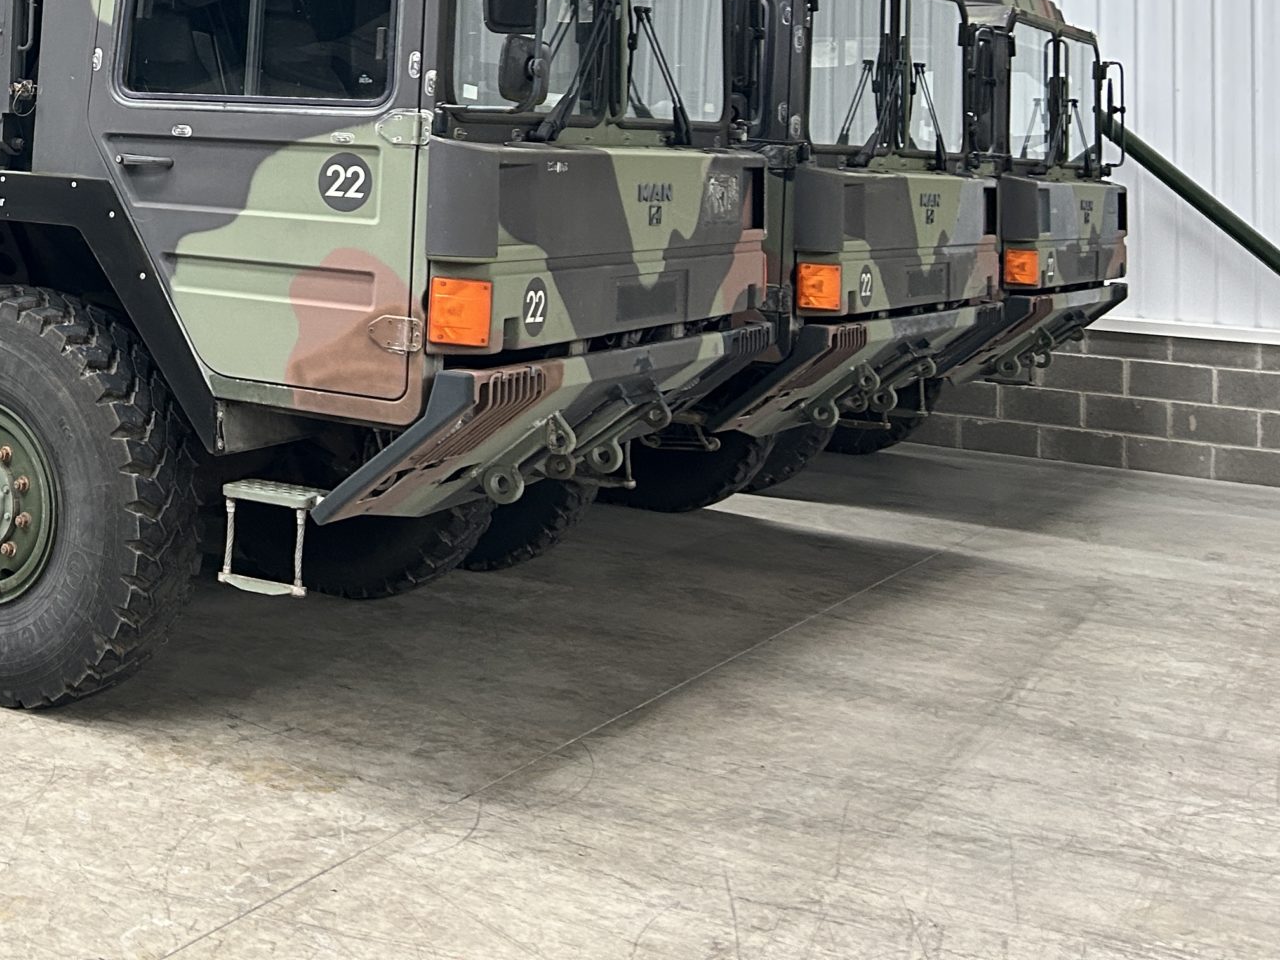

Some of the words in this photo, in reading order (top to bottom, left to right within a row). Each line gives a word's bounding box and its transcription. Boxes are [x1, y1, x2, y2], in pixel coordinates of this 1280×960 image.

[324, 164, 366, 199] 22
[638, 183, 673, 202] MAN
[861, 273, 872, 296] 22
[525, 290, 545, 323] 22
